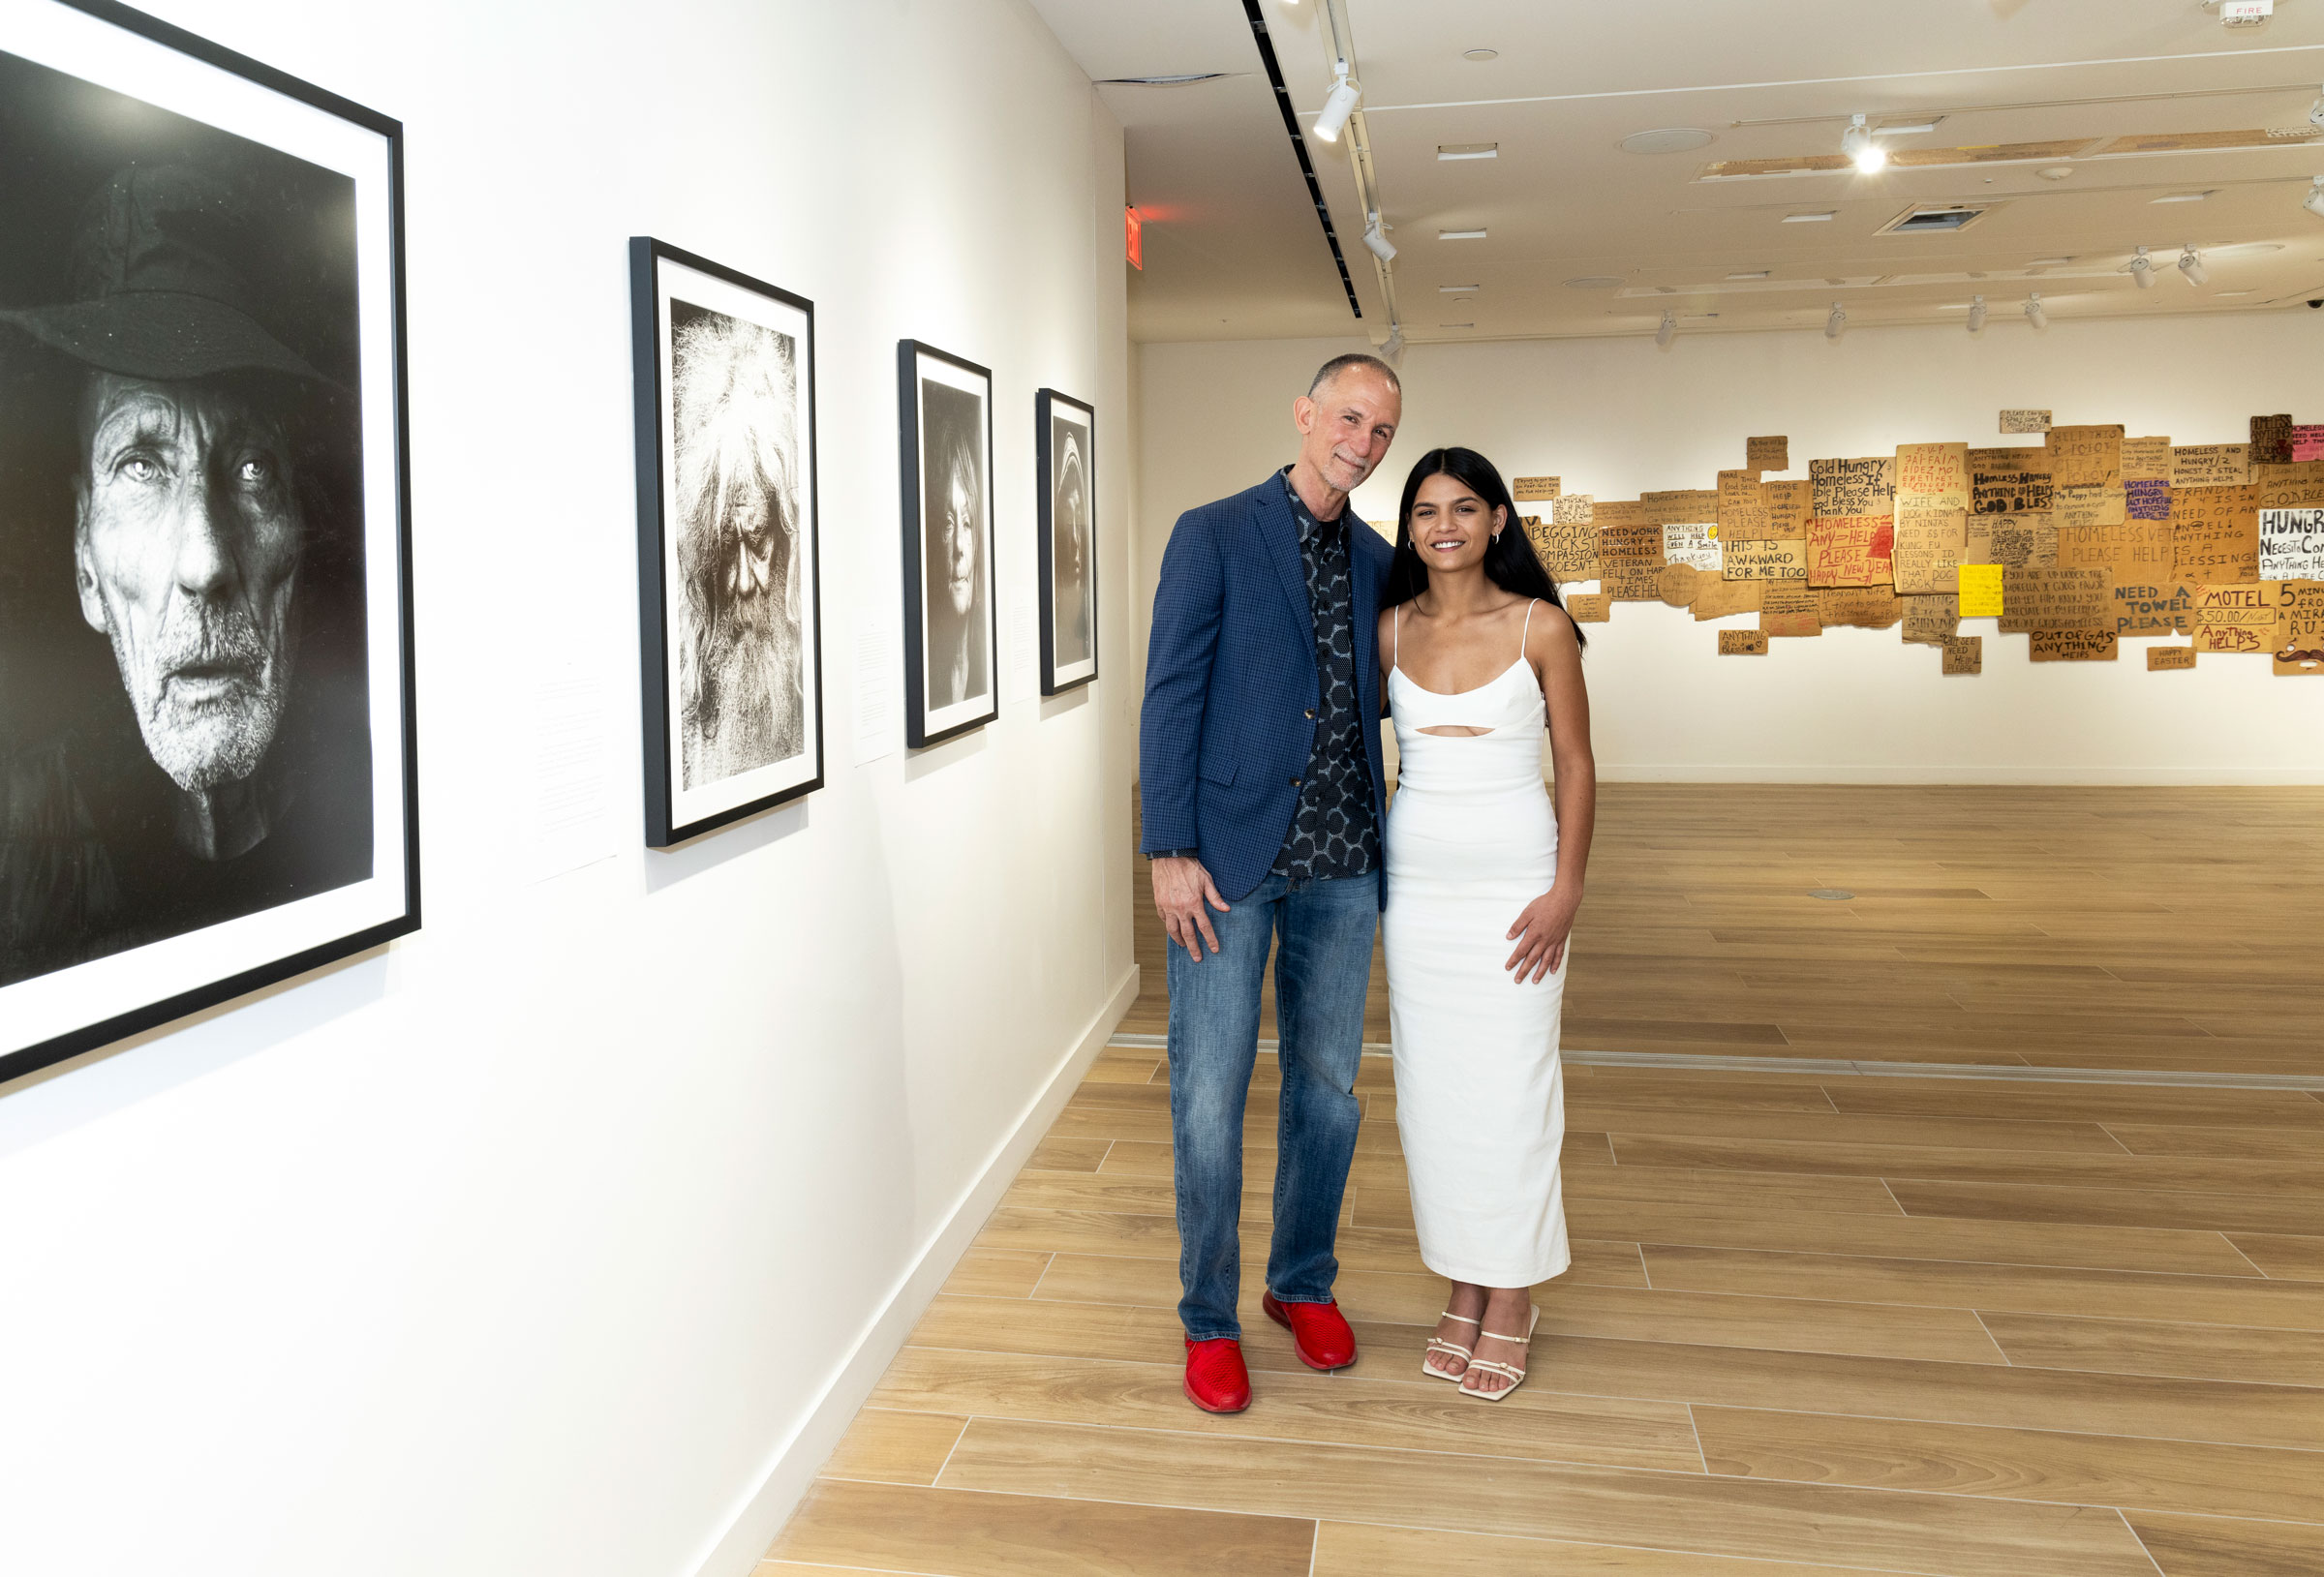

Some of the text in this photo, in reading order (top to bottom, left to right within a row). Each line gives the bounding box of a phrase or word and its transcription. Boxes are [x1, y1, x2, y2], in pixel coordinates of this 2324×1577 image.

[2235, 7, 2263, 15] FIRE
[2174, 446, 2218, 457] HOMELESS
[1810, 459, 1887, 476] Cold Hungry
[2174, 467, 2203, 476] HONEST
[1812, 471, 1883, 486] Homeless If
[2124, 479, 2170, 490] HOMELESS
[2176, 476, 2211, 486] ANYTHING
[2267, 479, 2308, 489] ANYTHING
[1835, 485, 1870, 498] Please
[1873, 482, 1896, 501] Help
[2026, 484, 2054, 499] HELPS
[2054, 491, 2067, 500] My
[2089, 488, 2102, 498] had
[1832, 497, 1855, 506] Bless
[1900, 496, 1961, 507] WIFE AND
[1974, 497, 2053, 514] GOD BLESS
[2172, 494, 2255, 506] OF IS IN
[2259, 492, 2300, 509] GOD
[1722, 506, 1769, 517] HOMELESS
[1813, 506, 1843, 516] Thank
[2173, 505, 2258, 520] NEED OF AN
[1727, 516, 1768, 529] PLEASE
[1900, 519, 1911, 529] BY
[1992, 519, 2018, 529] HAPPY
[1532, 526, 1598, 540] BEGGING
[1603, 527, 1660, 537] NEED WORK
[1900, 529, 1920, 538] NEED
[1941, 528, 1958, 537] FOR
[2066, 526, 2145, 543] HOMELESS
[2172, 531, 2245, 543] ANYTHING
[1542, 538, 1595, 552] SUCKS!
[1603, 537, 1642, 546] HUNGRY
[1809, 530, 1876, 549] ANY HELP
[1900, 539, 1941, 549] KUNG FU
[1762, 540, 1779, 552] IS
[1603, 547, 1657, 558] HOMELESS
[1900, 550, 1935, 559] LESSONS
[2071, 546, 2169, 562] PLEASE HELP
[1604, 559, 1652, 568] VETERAN
[1727, 552, 1794, 567] AWKWARD
[1818, 549, 1861, 569] PLEASE
[1901, 558, 1958, 568] REALLY LIKE
[1604, 567, 1643, 580] FELL ON
[1727, 566, 1806, 579] FOR ME TOO
[1809, 568, 1837, 585] HAPPY
[1844, 561, 1864, 576] NEW
[1902, 568, 1953, 581] THAT DOG
[1607, 587, 1638, 599] PLEASE
[2114, 585, 2191, 599] NEED A
[2280, 583, 2297, 608] 5
[2204, 590, 2271, 608] MOTEL
[2125, 598, 2193, 615] TOWEL
[2278, 612, 2287, 622] A
[2117, 616, 2188, 634] PLEASE
[2032, 629, 2116, 644] OUT GAS
[2034, 641, 2108, 653] ANYTHING
[2209, 634, 2261, 652] HELPS
[2158, 649, 2182, 657] HAPPY
